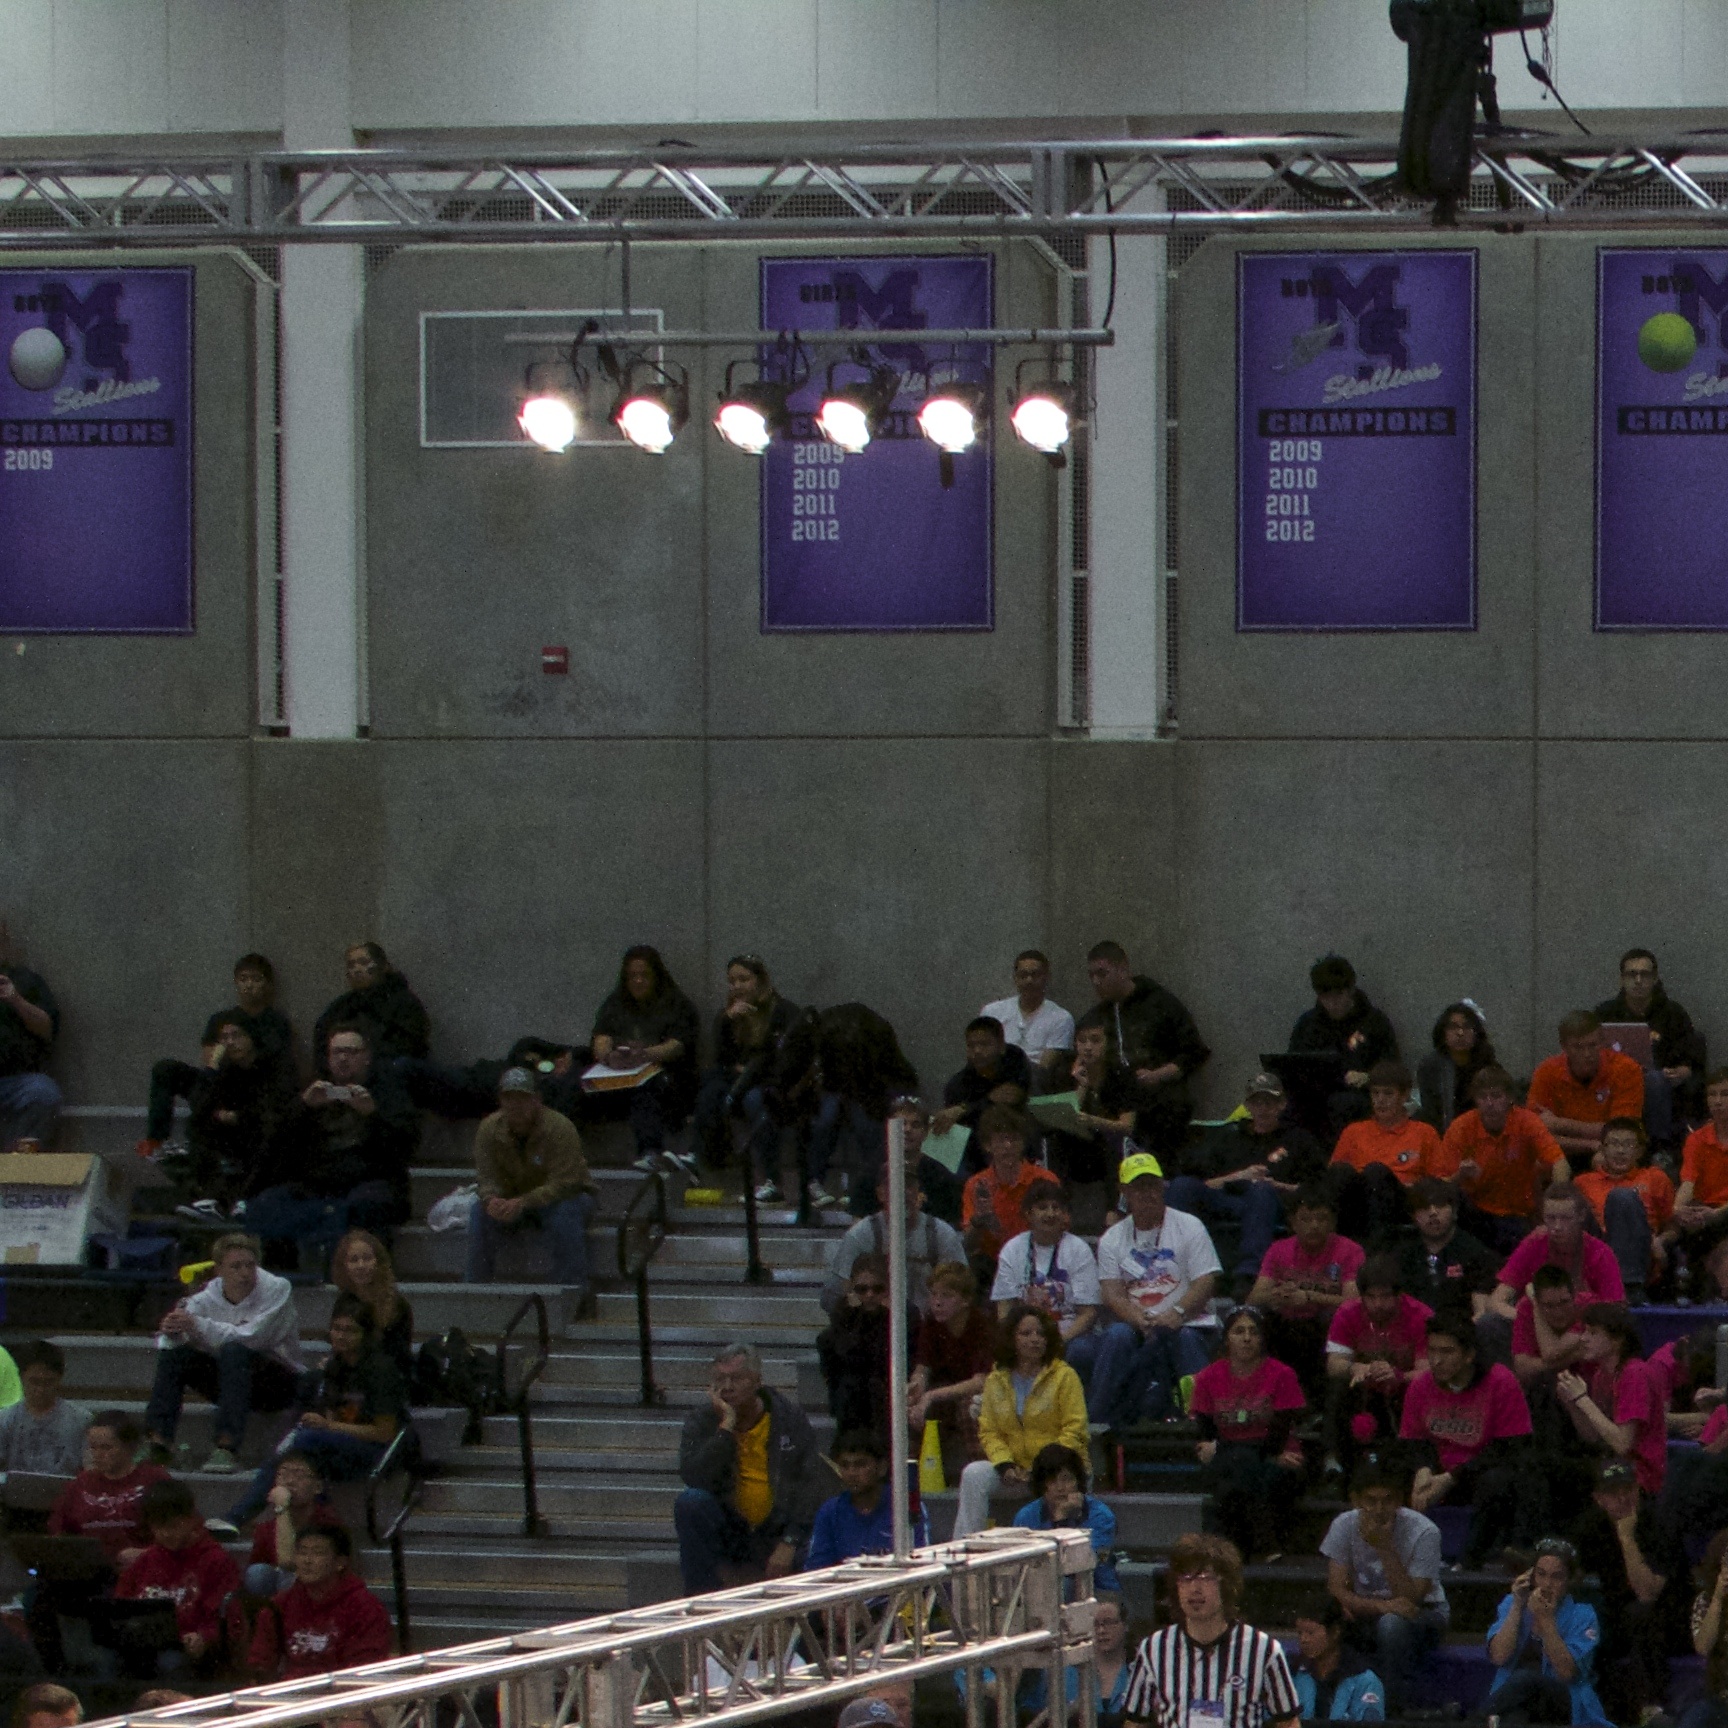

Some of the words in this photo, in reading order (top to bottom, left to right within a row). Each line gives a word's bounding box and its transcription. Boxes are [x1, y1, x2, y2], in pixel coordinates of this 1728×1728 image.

[2, 424, 168, 443] CHAMPIONS
[1267, 412, 1450, 433] CHAMPIONS
[5, 449, 53, 470] 2009
[1269, 440, 1323, 462] 2009
[793, 468, 840, 490] 2010
[1269, 467, 1318, 490] 2010
[792, 494, 837, 516] 2011
[1265, 494, 1311, 516] 2011
[791, 519, 840, 541] 2012
[1265, 519, 1316, 542] 2012
